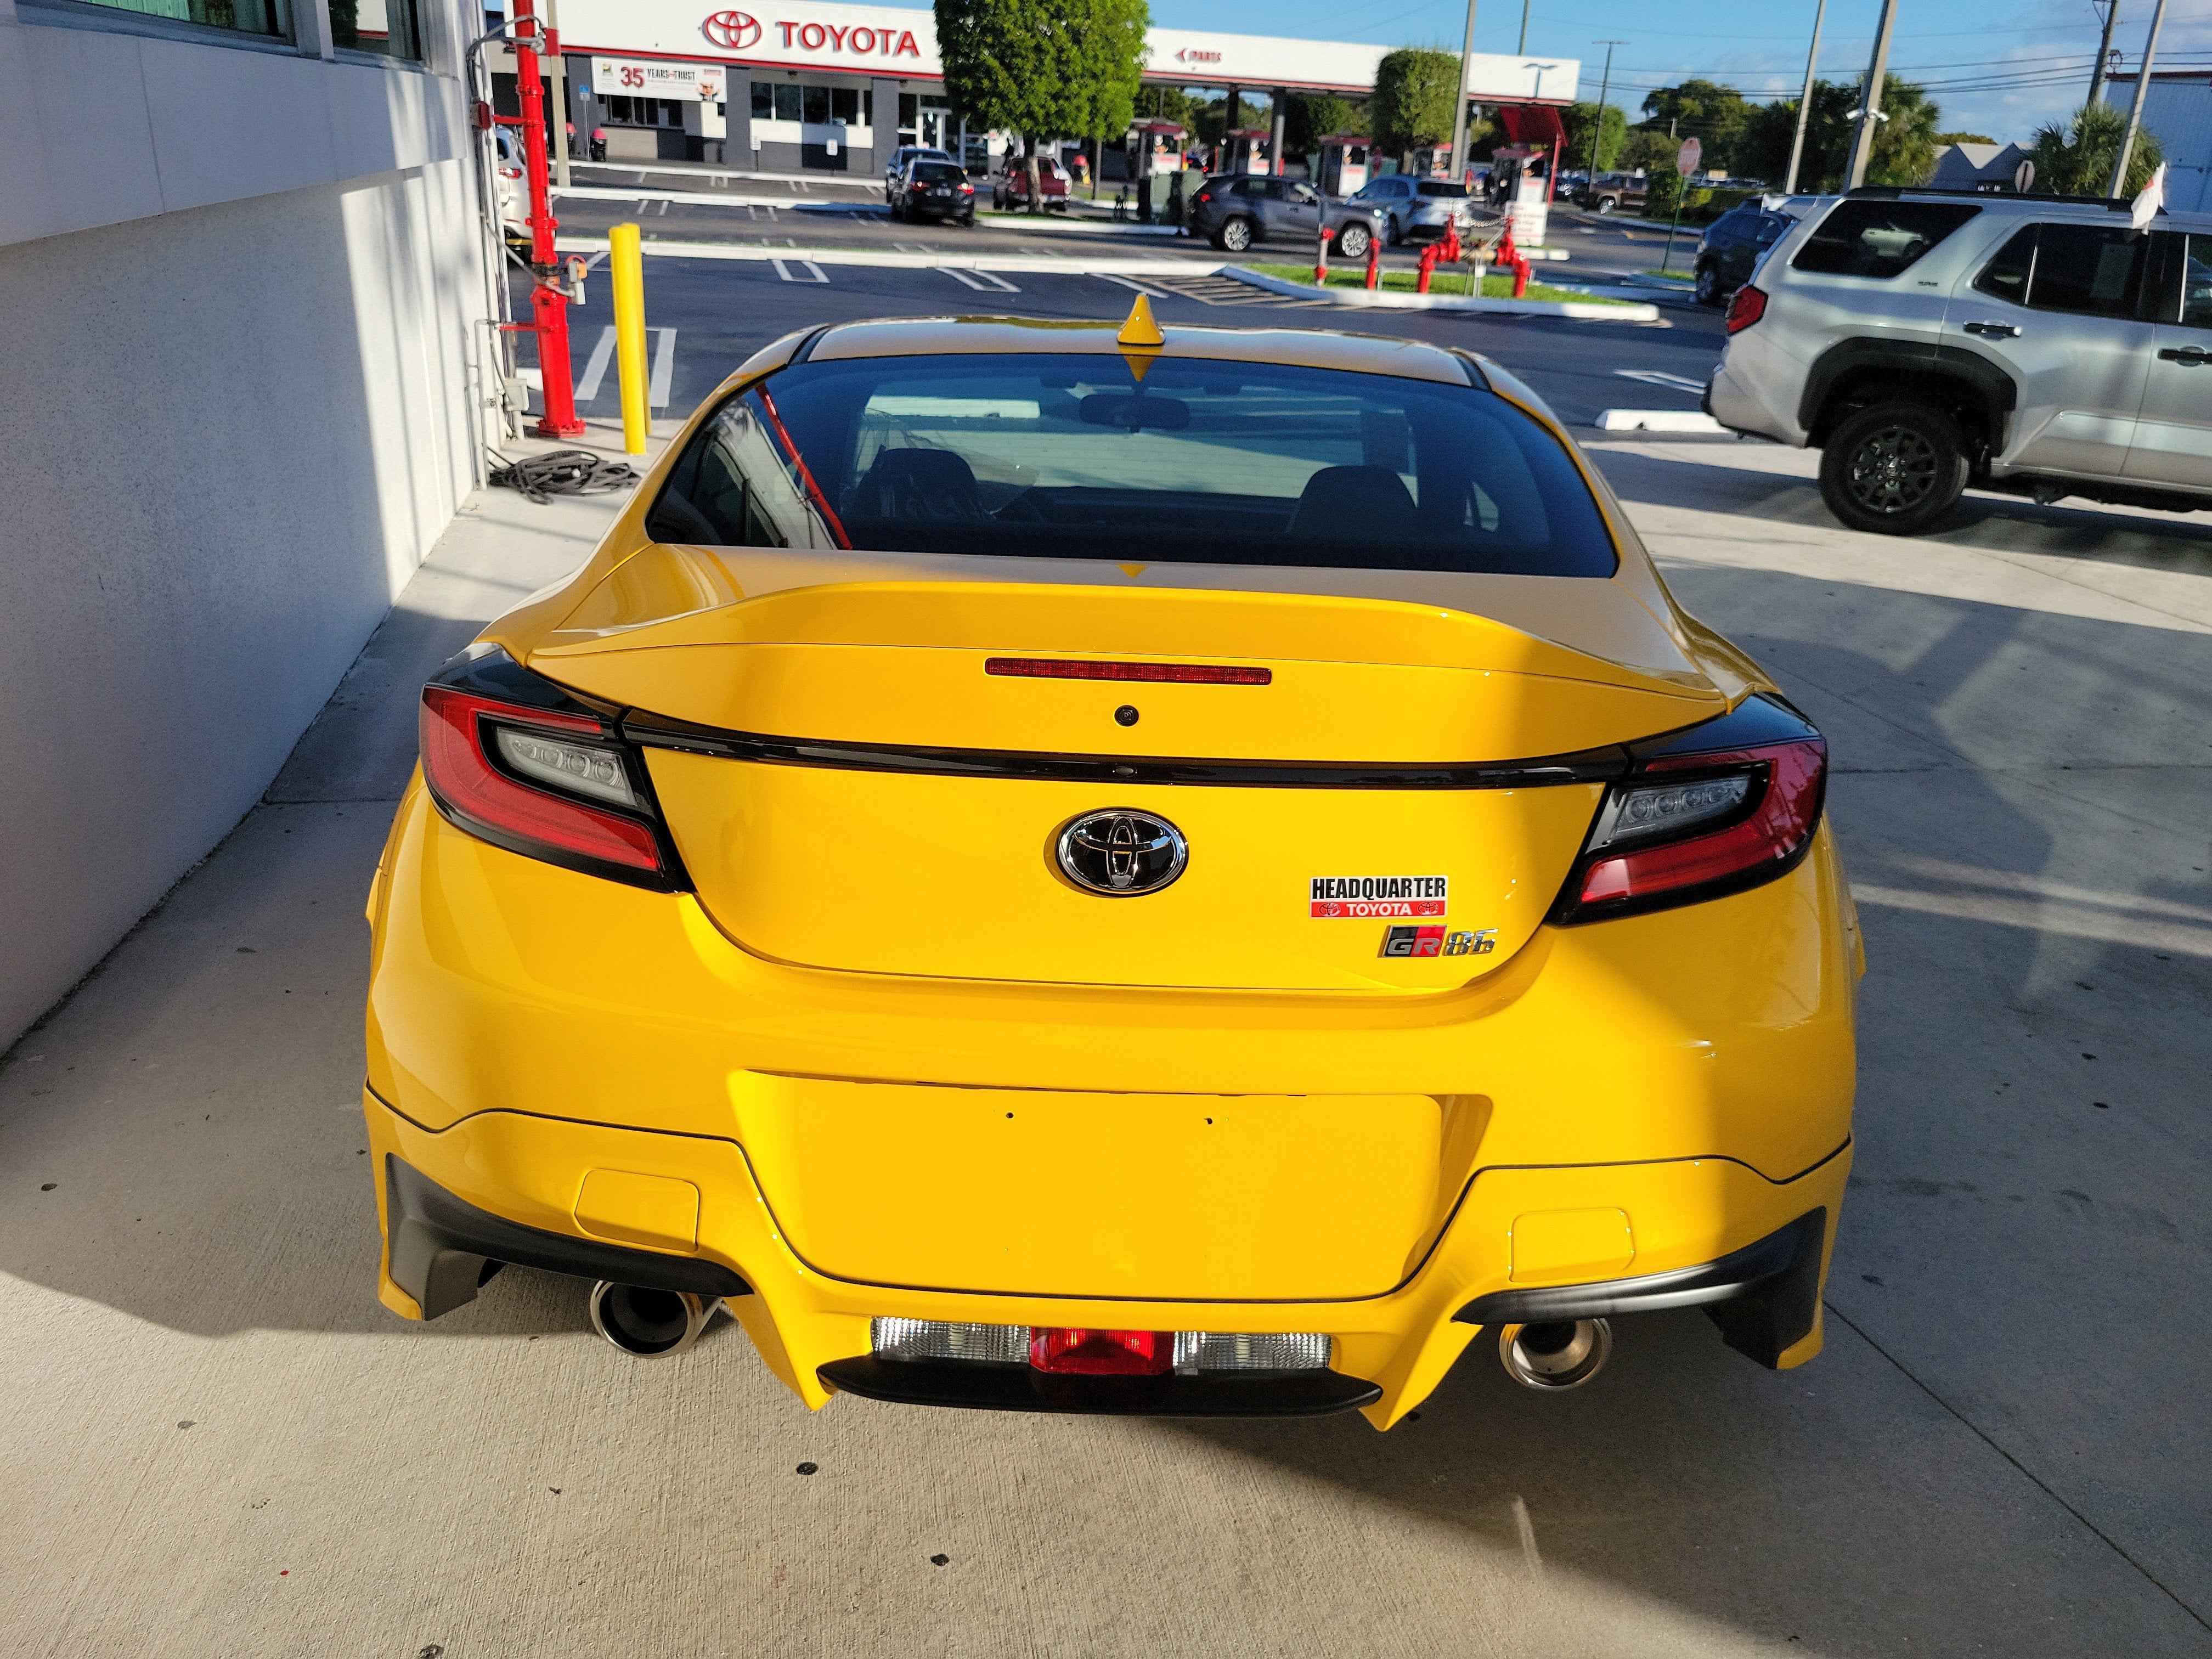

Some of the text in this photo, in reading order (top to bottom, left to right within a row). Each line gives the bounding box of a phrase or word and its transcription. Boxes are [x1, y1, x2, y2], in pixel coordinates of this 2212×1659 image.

[776, 21, 920, 57] TOYOTA
[620, 66, 645, 87] 35
[647, 68, 669, 79] YEARS
[674, 70, 695, 81] TRUST
[1312, 877, 1446, 900] HEADQUARTER
[1346, 902, 1413, 916] TOYOTA
